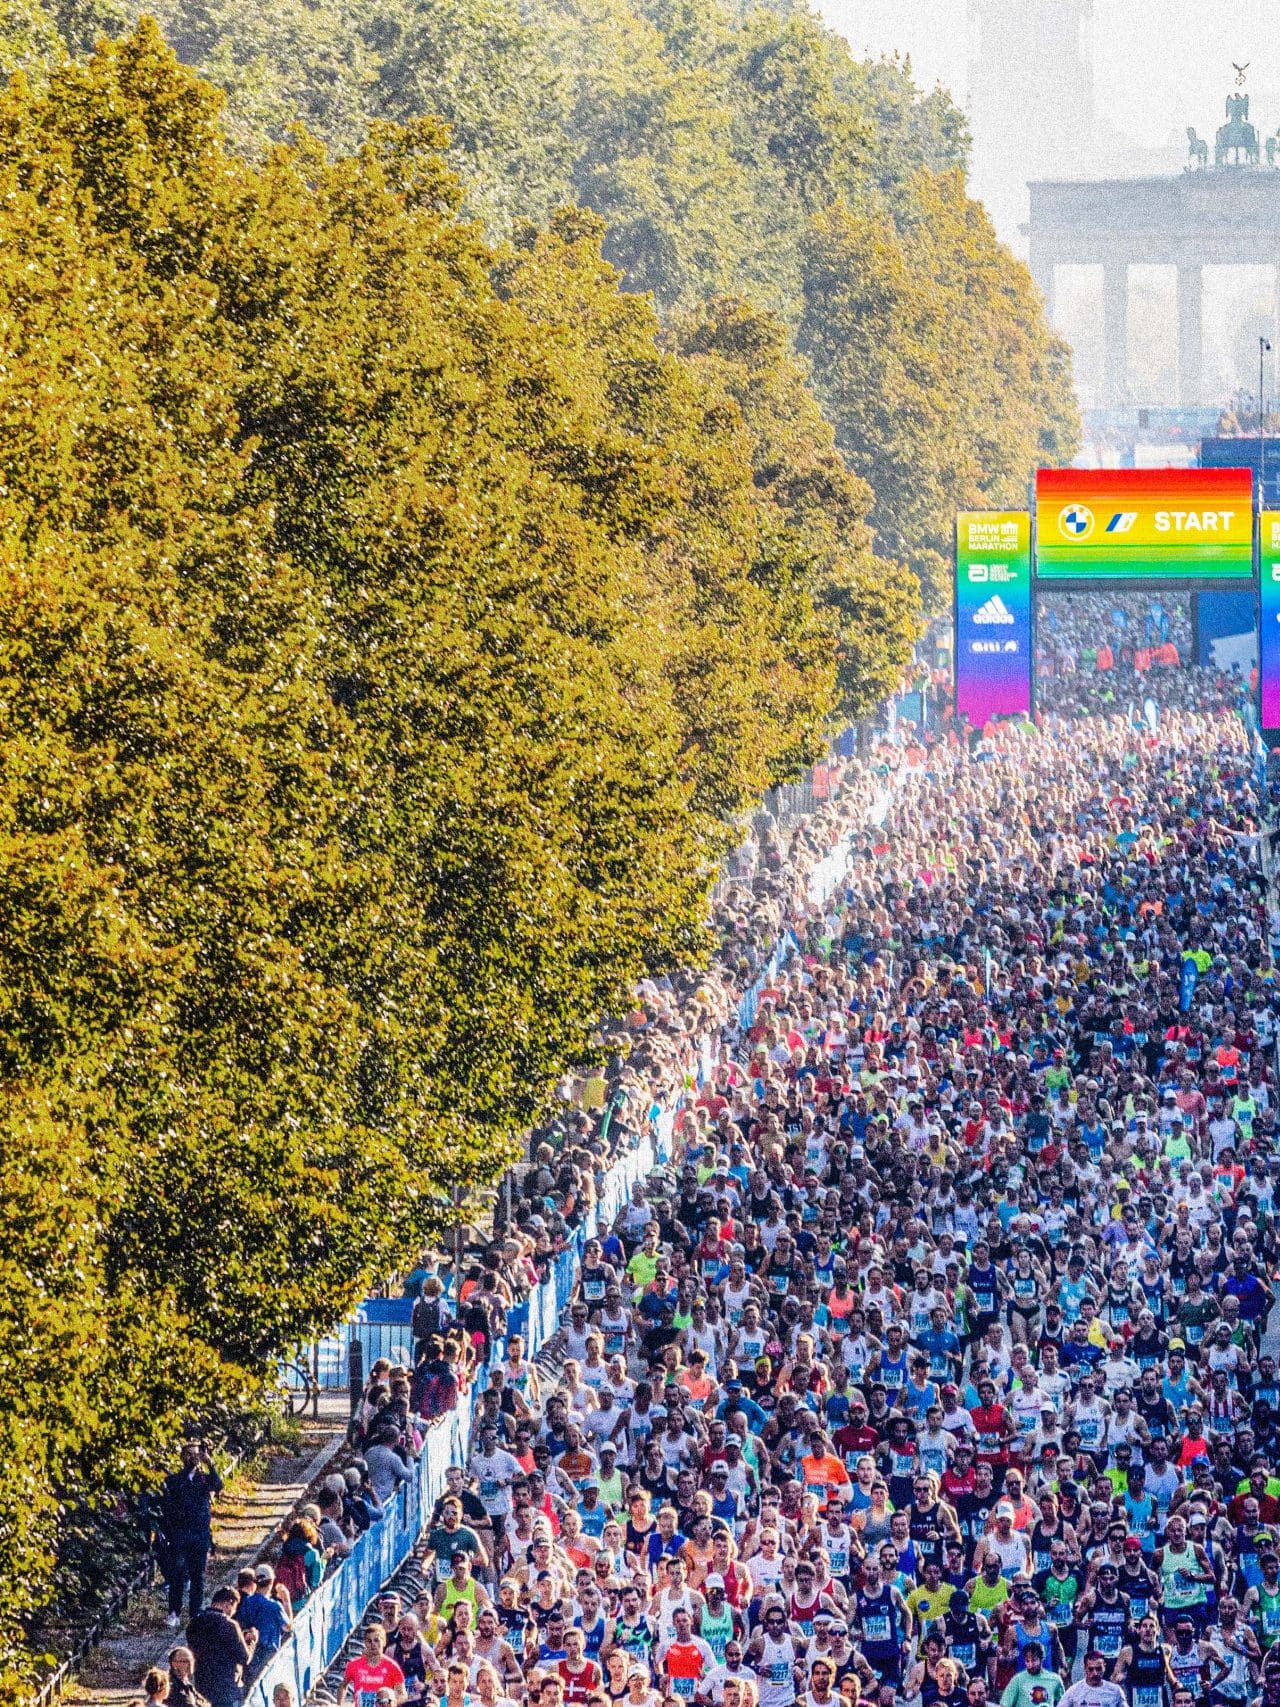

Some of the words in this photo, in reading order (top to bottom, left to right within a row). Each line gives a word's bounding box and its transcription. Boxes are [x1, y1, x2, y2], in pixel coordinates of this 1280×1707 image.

[1154, 511, 1235, 531] START
[968, 523, 999, 534] BMW
[968, 542, 1018, 550] MARATHON
